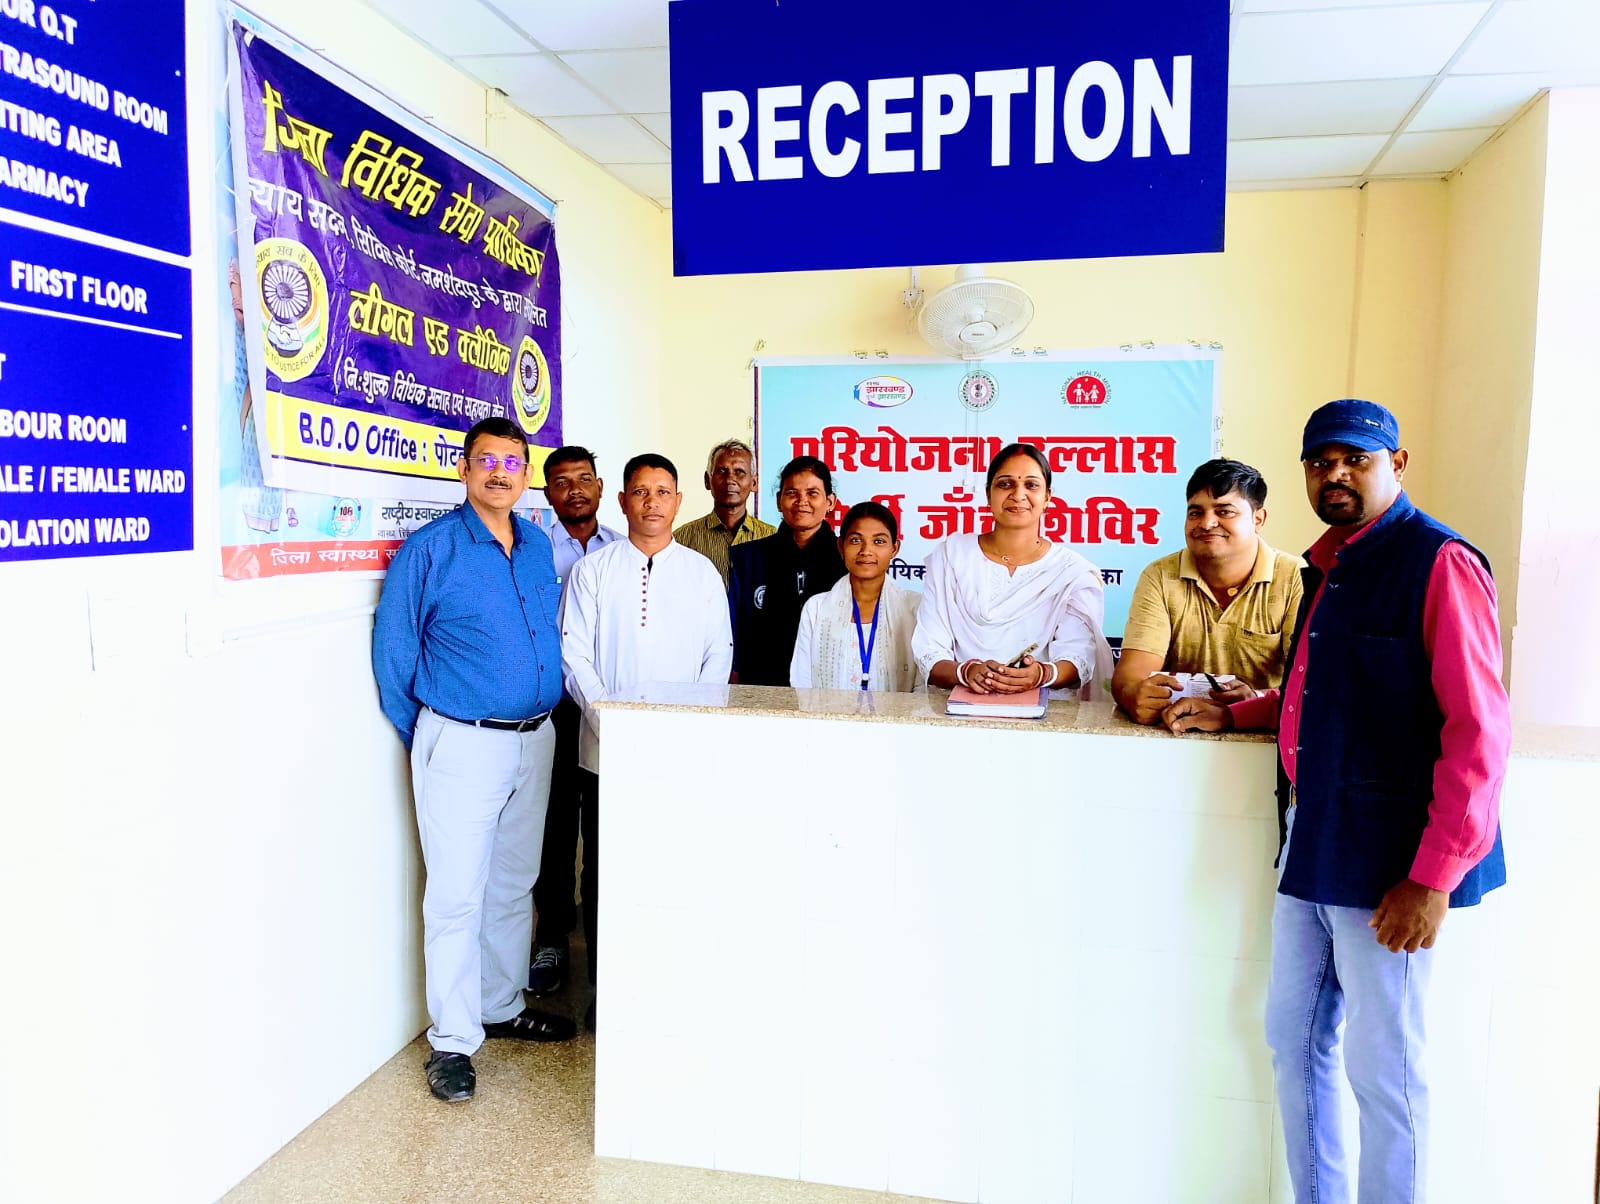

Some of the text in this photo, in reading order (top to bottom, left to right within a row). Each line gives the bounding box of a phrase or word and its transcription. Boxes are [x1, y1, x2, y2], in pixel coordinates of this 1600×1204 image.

[0, 0, 78, 45] OR O.T
[113, 90, 168, 136] ROOM
[701, 54, 1193, 184] RECEPTION
[66, 125, 122, 168] AREA
[0, 155, 89, 208] ARMACY
[340, 129, 442, 217] विधिक
[439, 182, 485, 244] सेवा
[10, 259, 148, 314] FIRST FLOOR
[420, 263, 485, 309] जमशेदपुर
[481, 277, 500, 305] के
[498, 289, 522, 315] द्वारा
[348, 282, 415, 347] लीगल
[423, 316, 449, 356] एड
[392, 369, 428, 405] विधिक
[427, 387, 451, 415] सलाह
[452, 388, 465, 415] एवं
[0, 408, 126, 443] BOUR ROOM
[299, 412, 360, 451] B.D.O
[366, 425, 417, 461] Office
[790, 425, 1003, 472] परियोजना
[51, 466, 130, 493] FEMALE
[134, 469, 185, 493] WARD
[0, 517, 150, 548] OLATION WARD
[381, 501, 413, 526] राष्ट्रीय
[270, 547, 311, 566] जिला
[317, 549, 379, 563] स्वास्थ्य
[1100, 569, 1124, 586] का
